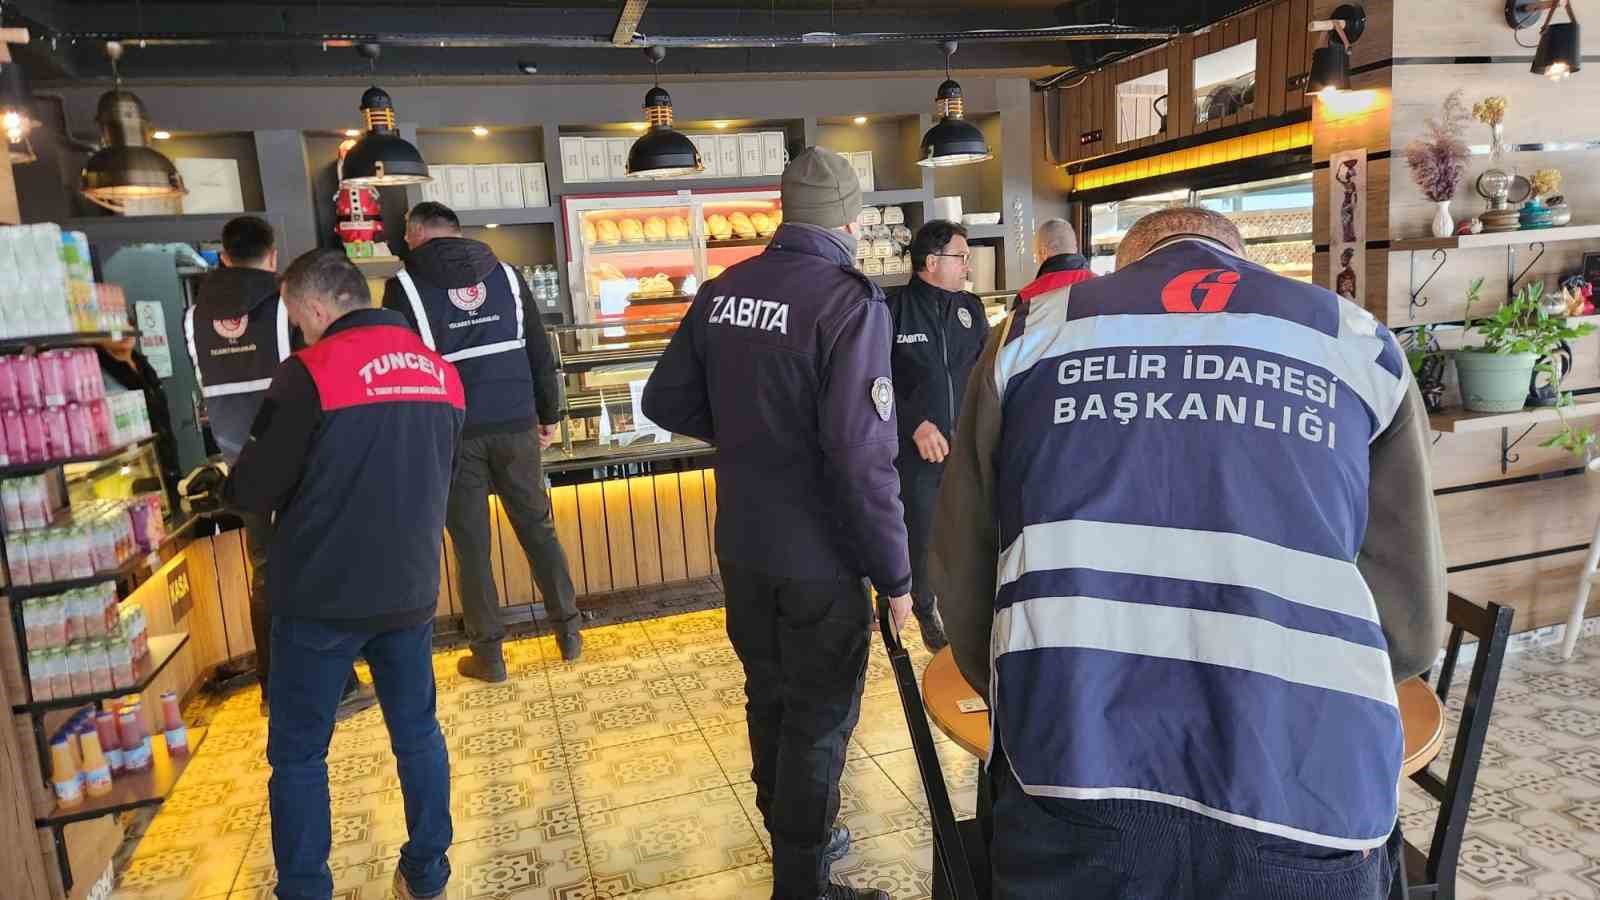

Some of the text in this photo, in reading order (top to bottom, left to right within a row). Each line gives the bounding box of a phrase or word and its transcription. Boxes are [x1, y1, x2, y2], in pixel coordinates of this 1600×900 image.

[708, 296, 789, 335] ZABITA
[896, 333, 928, 344] ZABITA
[1057, 349, 1339, 408] GELİR İDARESİ
[1054, 392, 1335, 449] BAŞKANLIĞI
